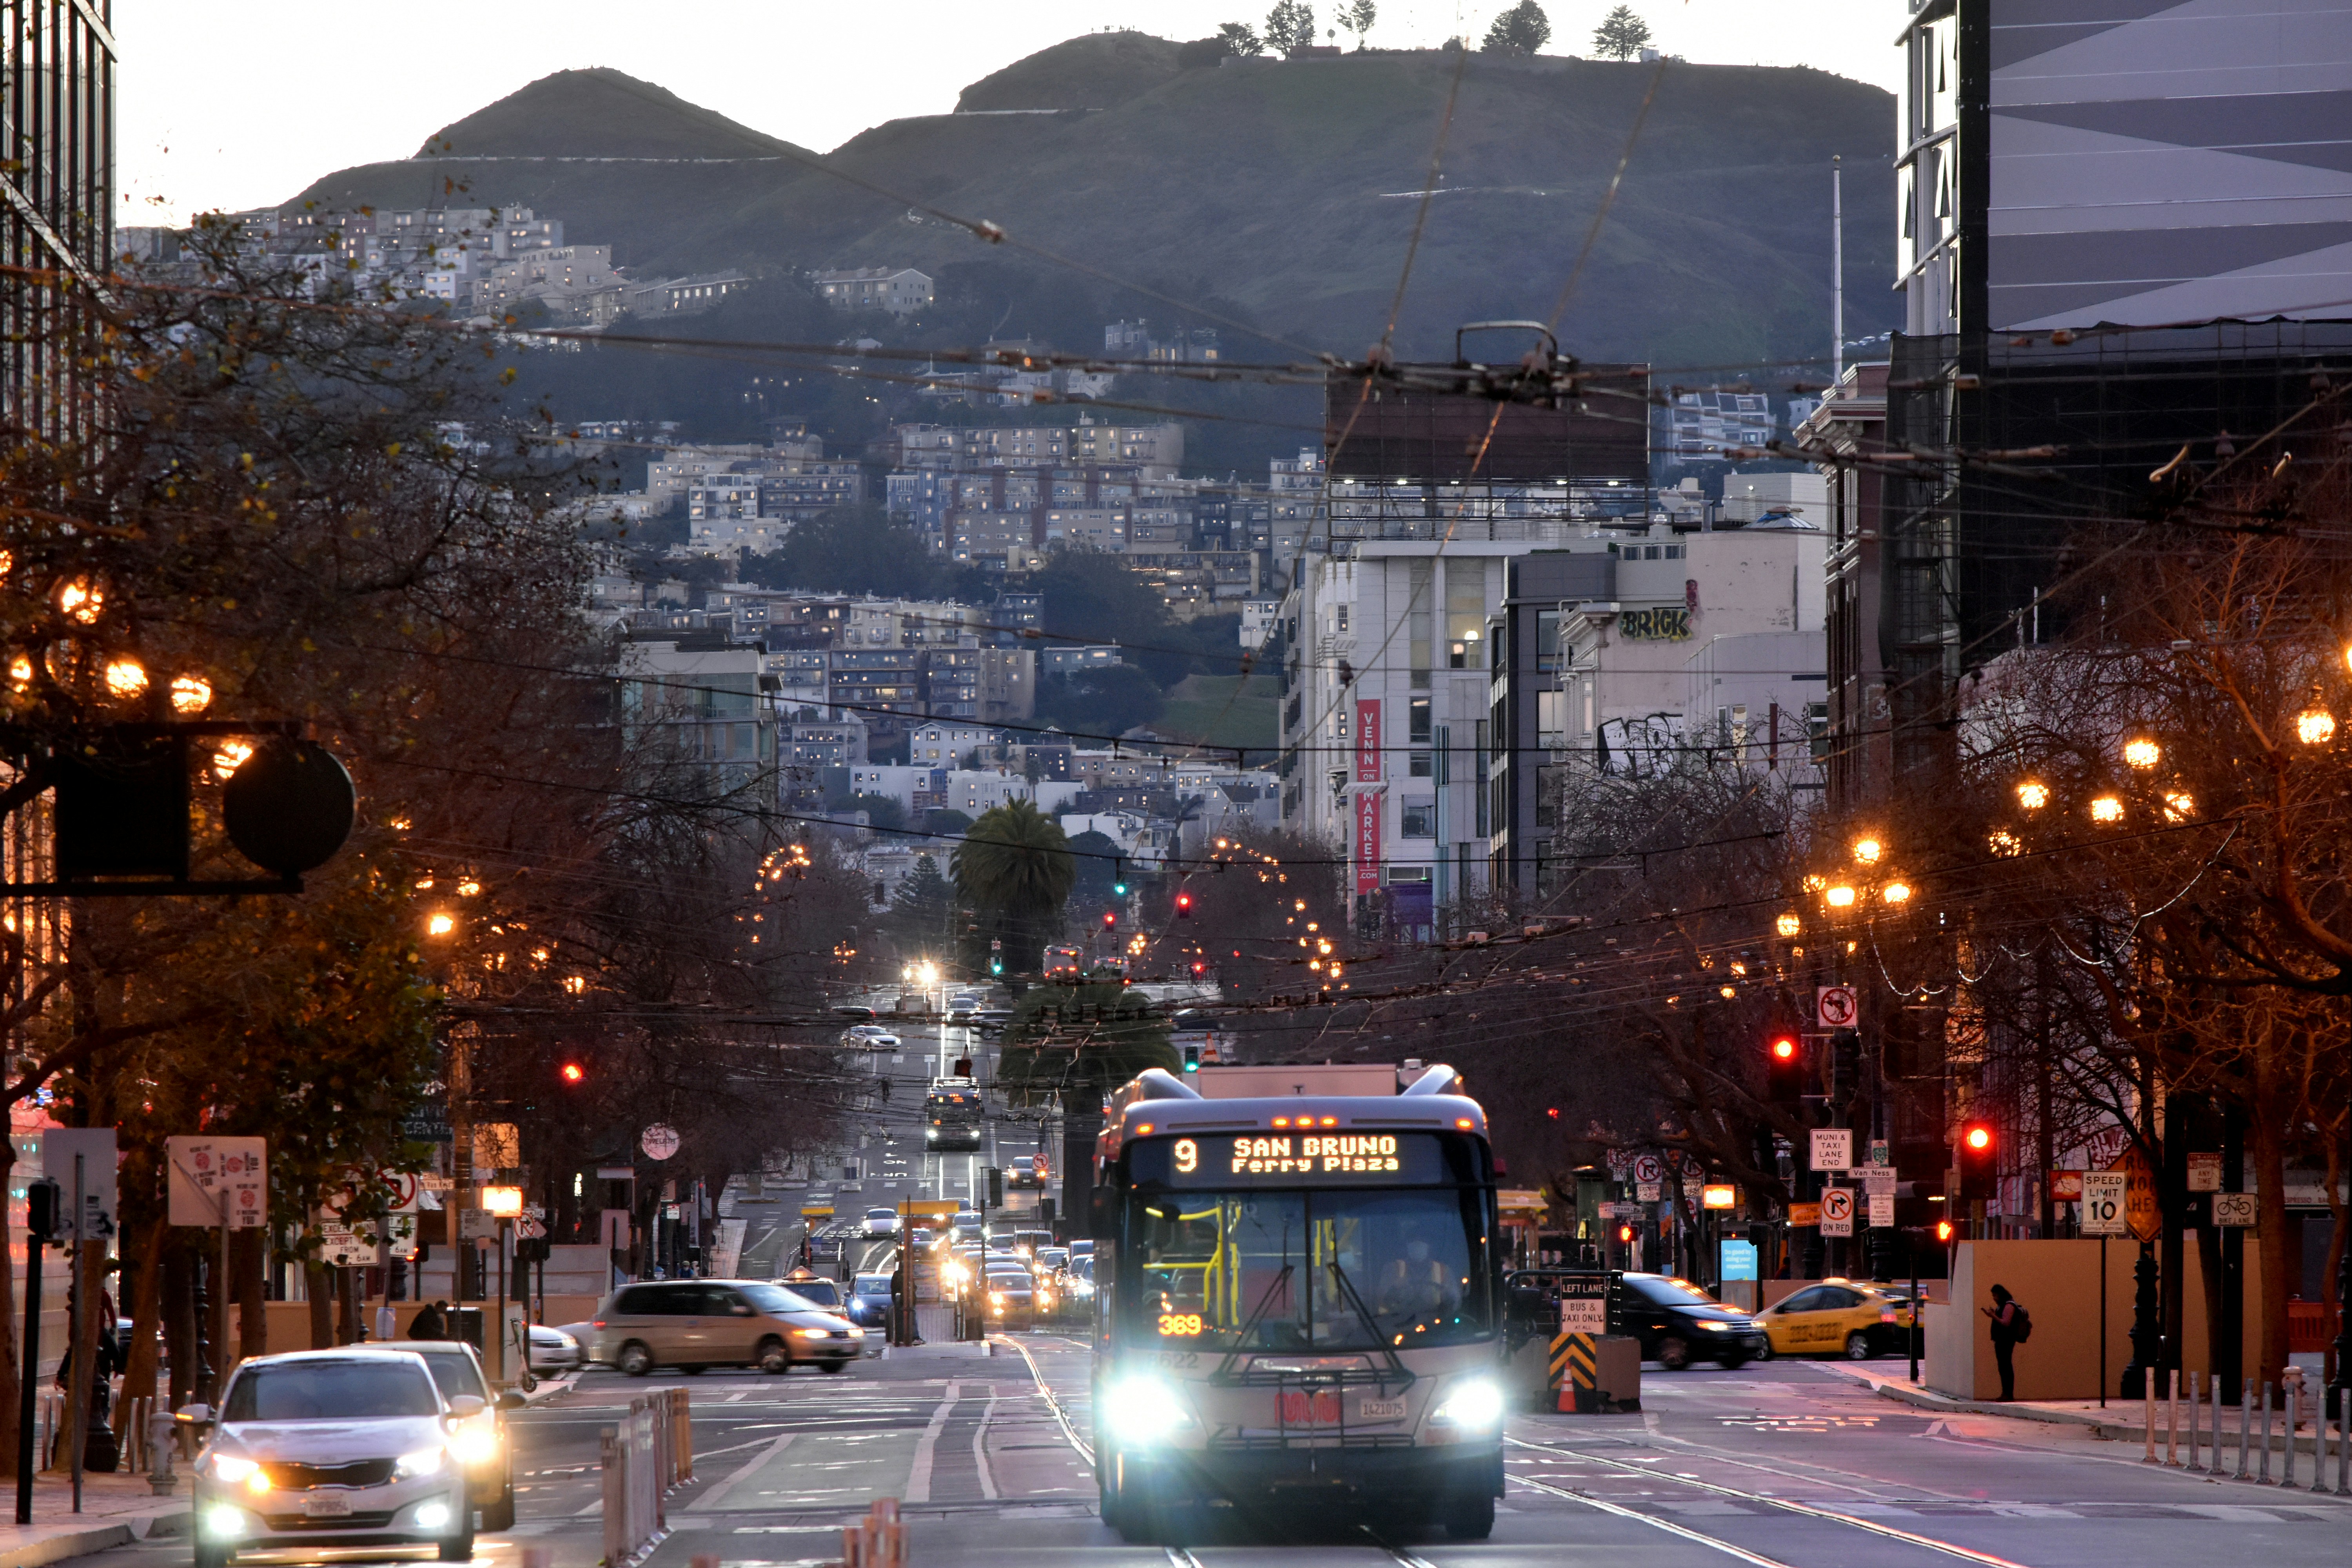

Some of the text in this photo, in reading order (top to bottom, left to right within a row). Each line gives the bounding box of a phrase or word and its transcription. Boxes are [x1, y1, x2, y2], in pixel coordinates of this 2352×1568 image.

[1621, 610, 1691, 638] BRICK
[1364, 713, 1373, 765] VENN
[1363, 793, 1373, 868] MARKET
[1175, 1136, 1396, 1172] 9 SAN BRUNO
[1232, 1156, 1399, 1173] Ferry Plaza
[2091, 1201, 2116, 1220] 10
[1563, 1284, 1603, 1293] LEFT LANE
[1570, 1303, 1595, 1311] BUS &
[1158, 1314, 1202, 1336] 369
